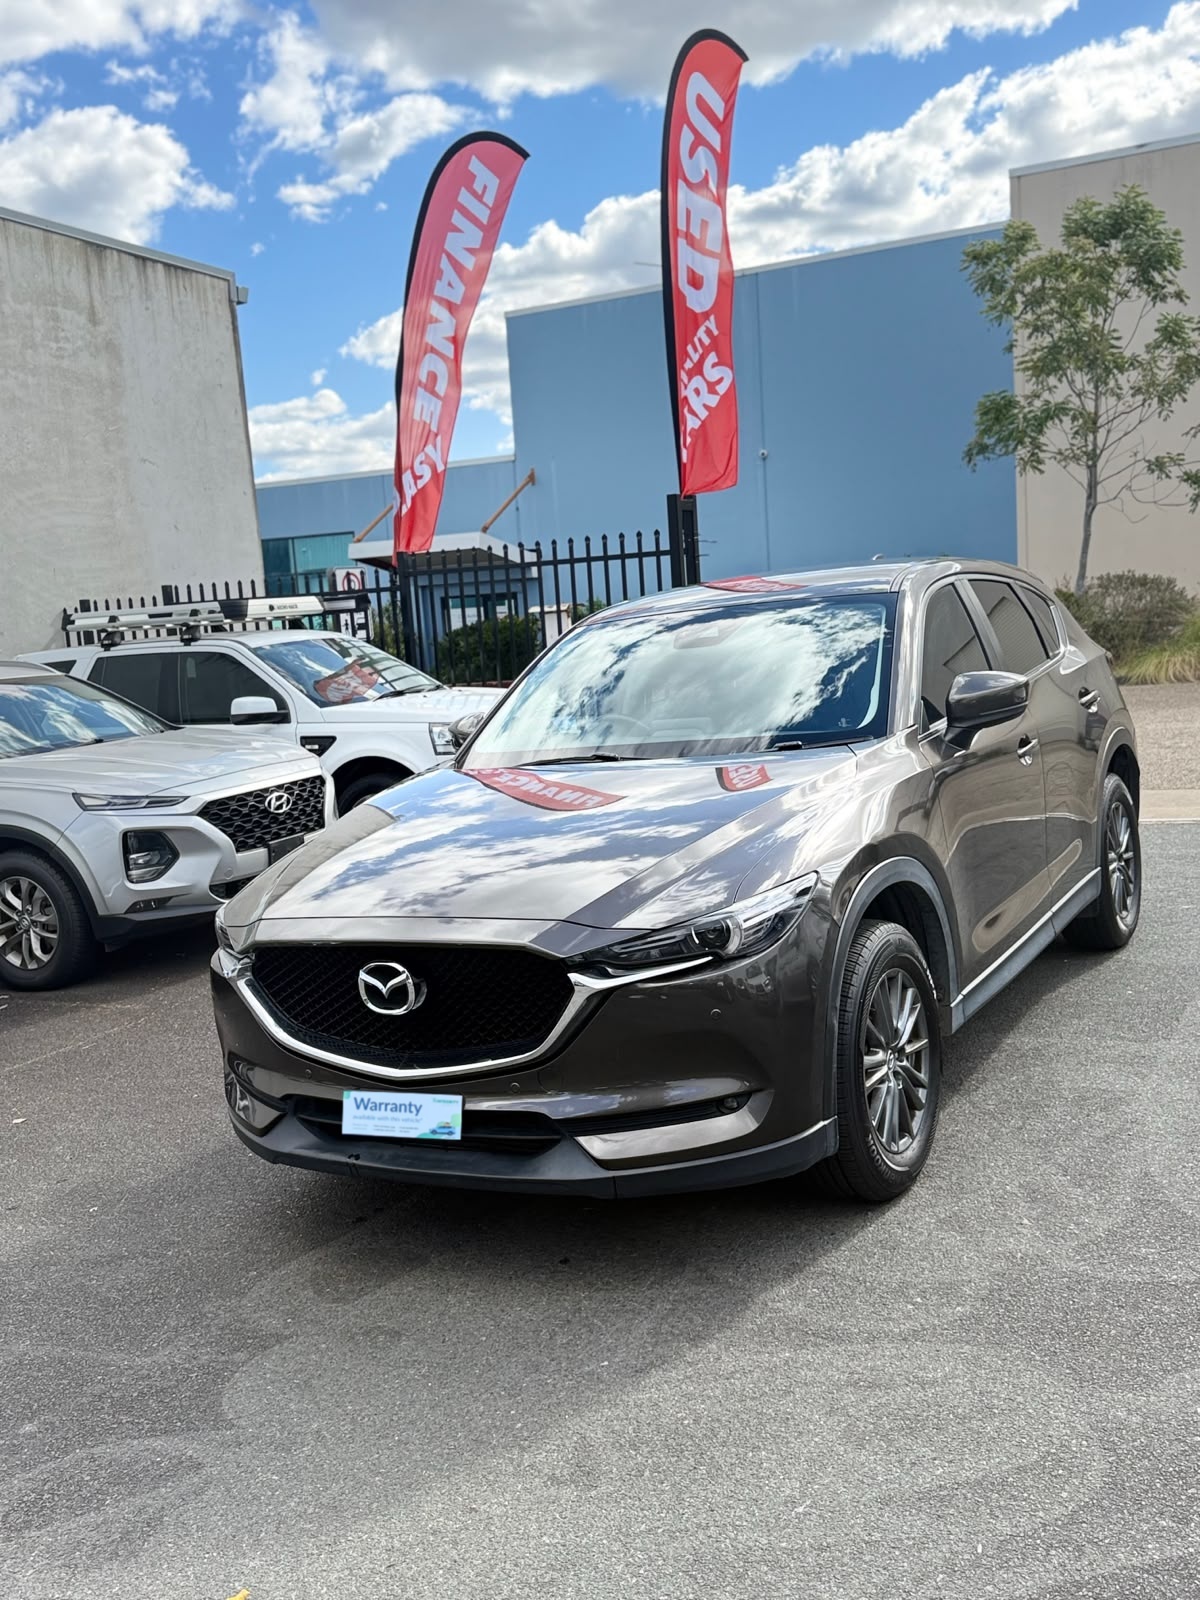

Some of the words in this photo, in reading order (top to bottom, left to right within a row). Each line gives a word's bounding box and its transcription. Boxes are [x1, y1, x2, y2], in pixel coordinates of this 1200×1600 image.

[677, 70, 725, 313] USED
[413, 155, 500, 432] FINANCE
[681, 351, 733, 463] ARS
[353, 1096, 423, 1117] Warranty
